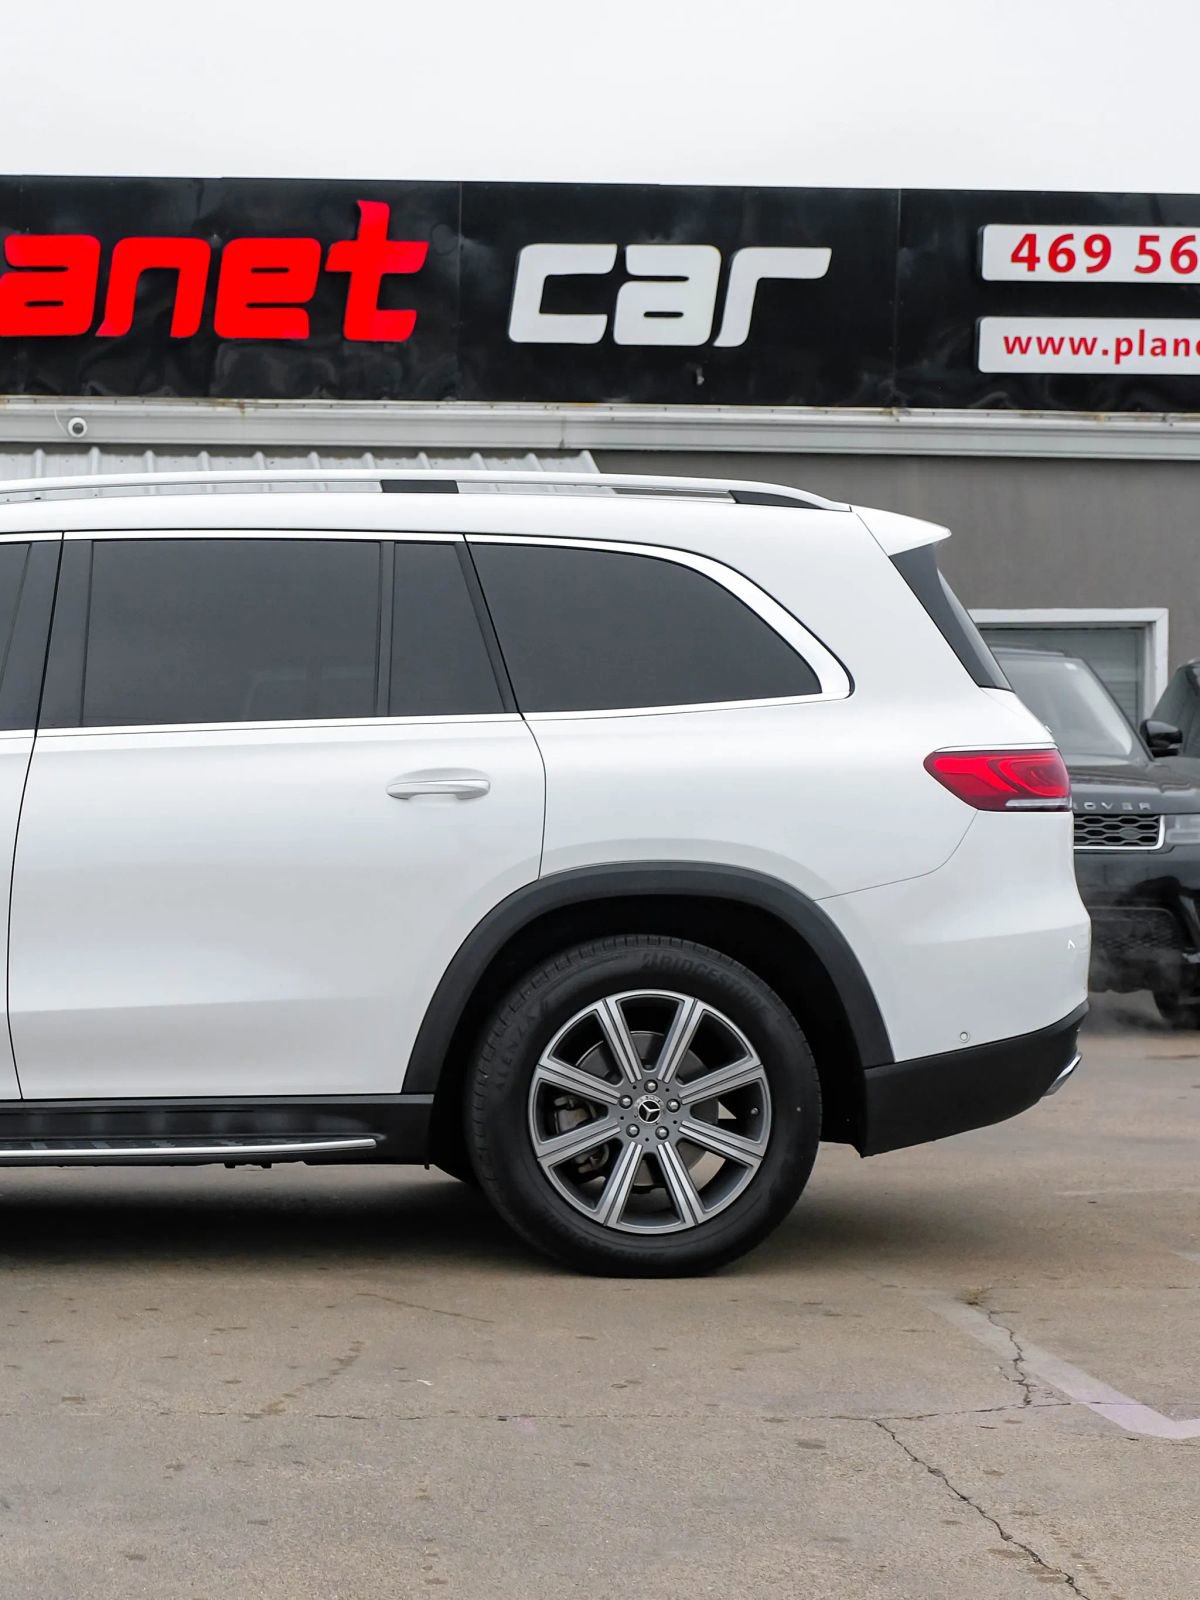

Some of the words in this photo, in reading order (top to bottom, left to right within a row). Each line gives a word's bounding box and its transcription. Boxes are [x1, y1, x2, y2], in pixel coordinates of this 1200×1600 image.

[1010, 233, 1111, 273] 469
[1135, 234, 1198, 275] 56
[507, 242, 833, 347] car
